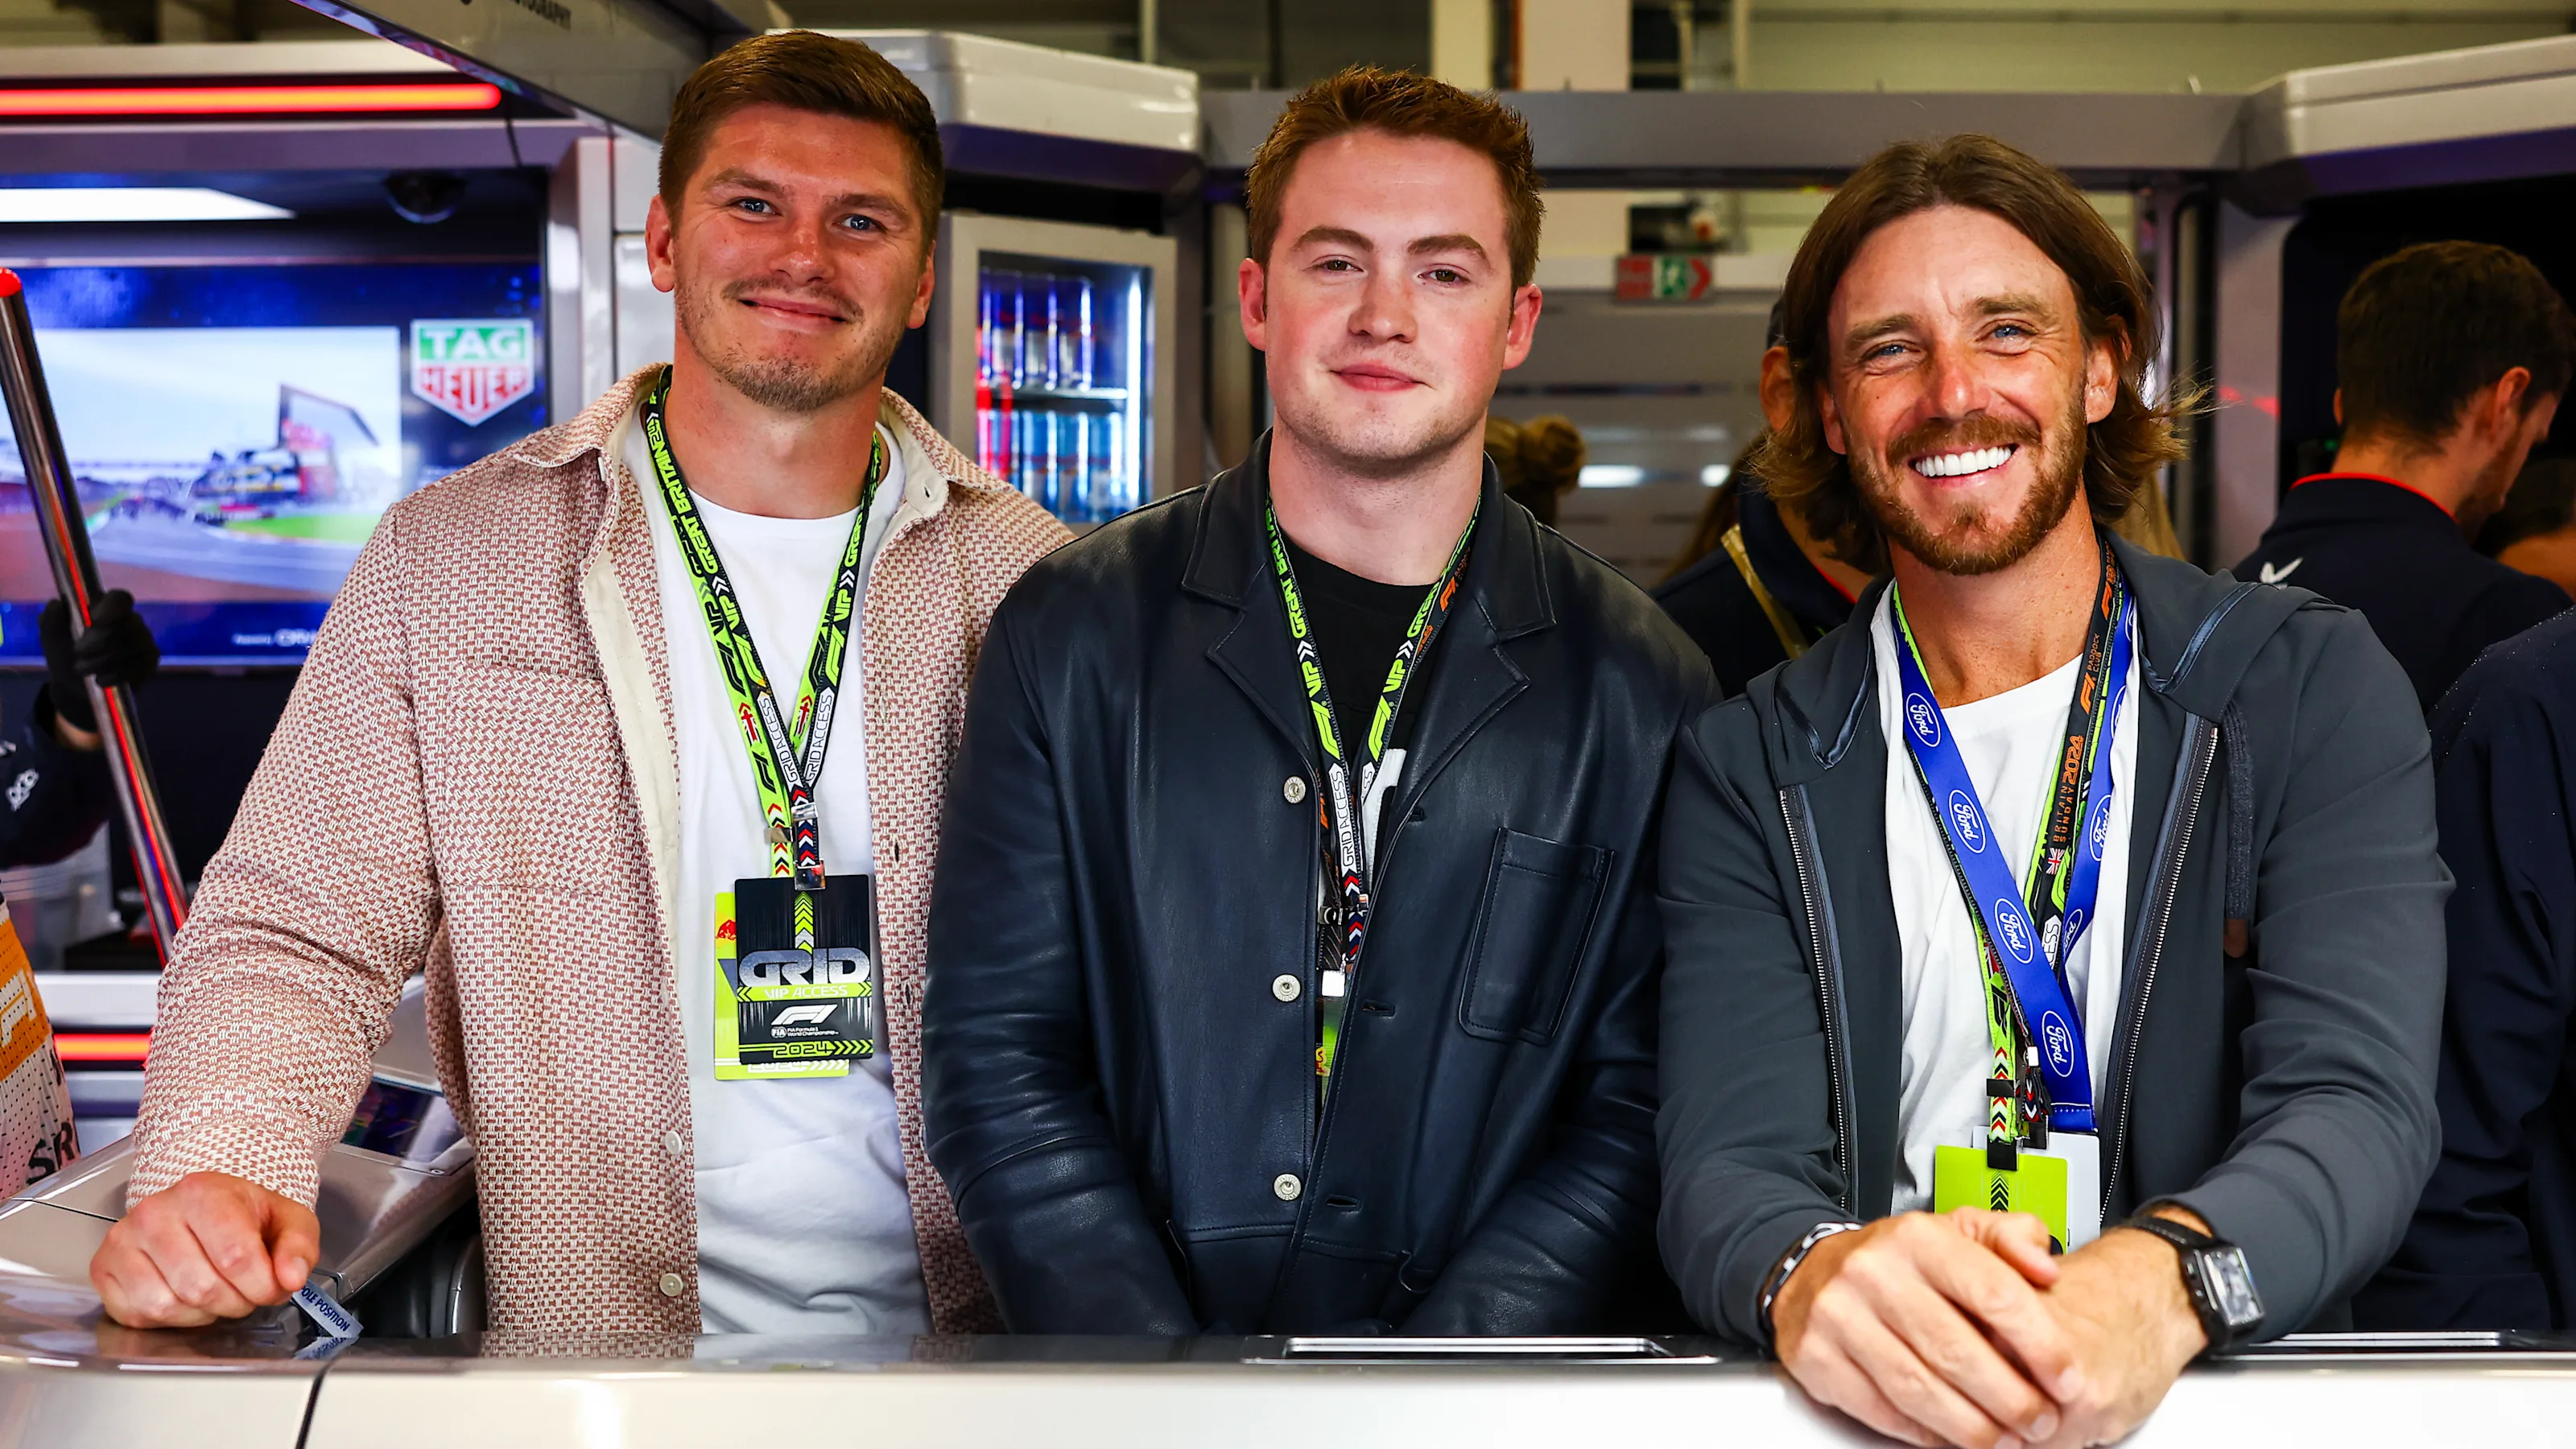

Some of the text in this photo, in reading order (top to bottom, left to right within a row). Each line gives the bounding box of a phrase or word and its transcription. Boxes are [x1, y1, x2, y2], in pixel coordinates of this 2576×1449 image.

[425, 329, 520, 358] TAG
[422, 367, 524, 414] HEUER
[653, 441, 692, 515] BRITAIN
[680, 514, 718, 574] GREAT
[719, 595, 740, 630] VIP
[833, 588, 852, 622] VIP
[1280, 578, 1307, 638] GREAT
[2087, 634, 2099, 671] PADDOCK
[2093, 652, 2102, 672] CLUB
[1302, 660, 1322, 698] VIP
[1382, 658, 1406, 693] VIP
[805, 695, 832, 782] GRID ACCESS
[1910, 704, 1934, 736] Ford
[759, 698, 798, 782] GRID ACCESS
[2062, 735, 2084, 785] 2024
[1331, 770, 1357, 867] GRID ACCESS
[1953, 804, 1979, 840] Ford
[2054, 786, 2067, 842] BRITAIN
[2060, 788, 2074, 843] SUNDAY
[2000, 914, 2026, 951] Ford
[739, 947, 870, 987] GRID
[764, 985, 848, 999] VIP ACCESS
[775, 1042, 828, 1056] 2024
[2046, 1026, 2068, 1063] Ford
[315, 1298, 350, 1331] POSITION
